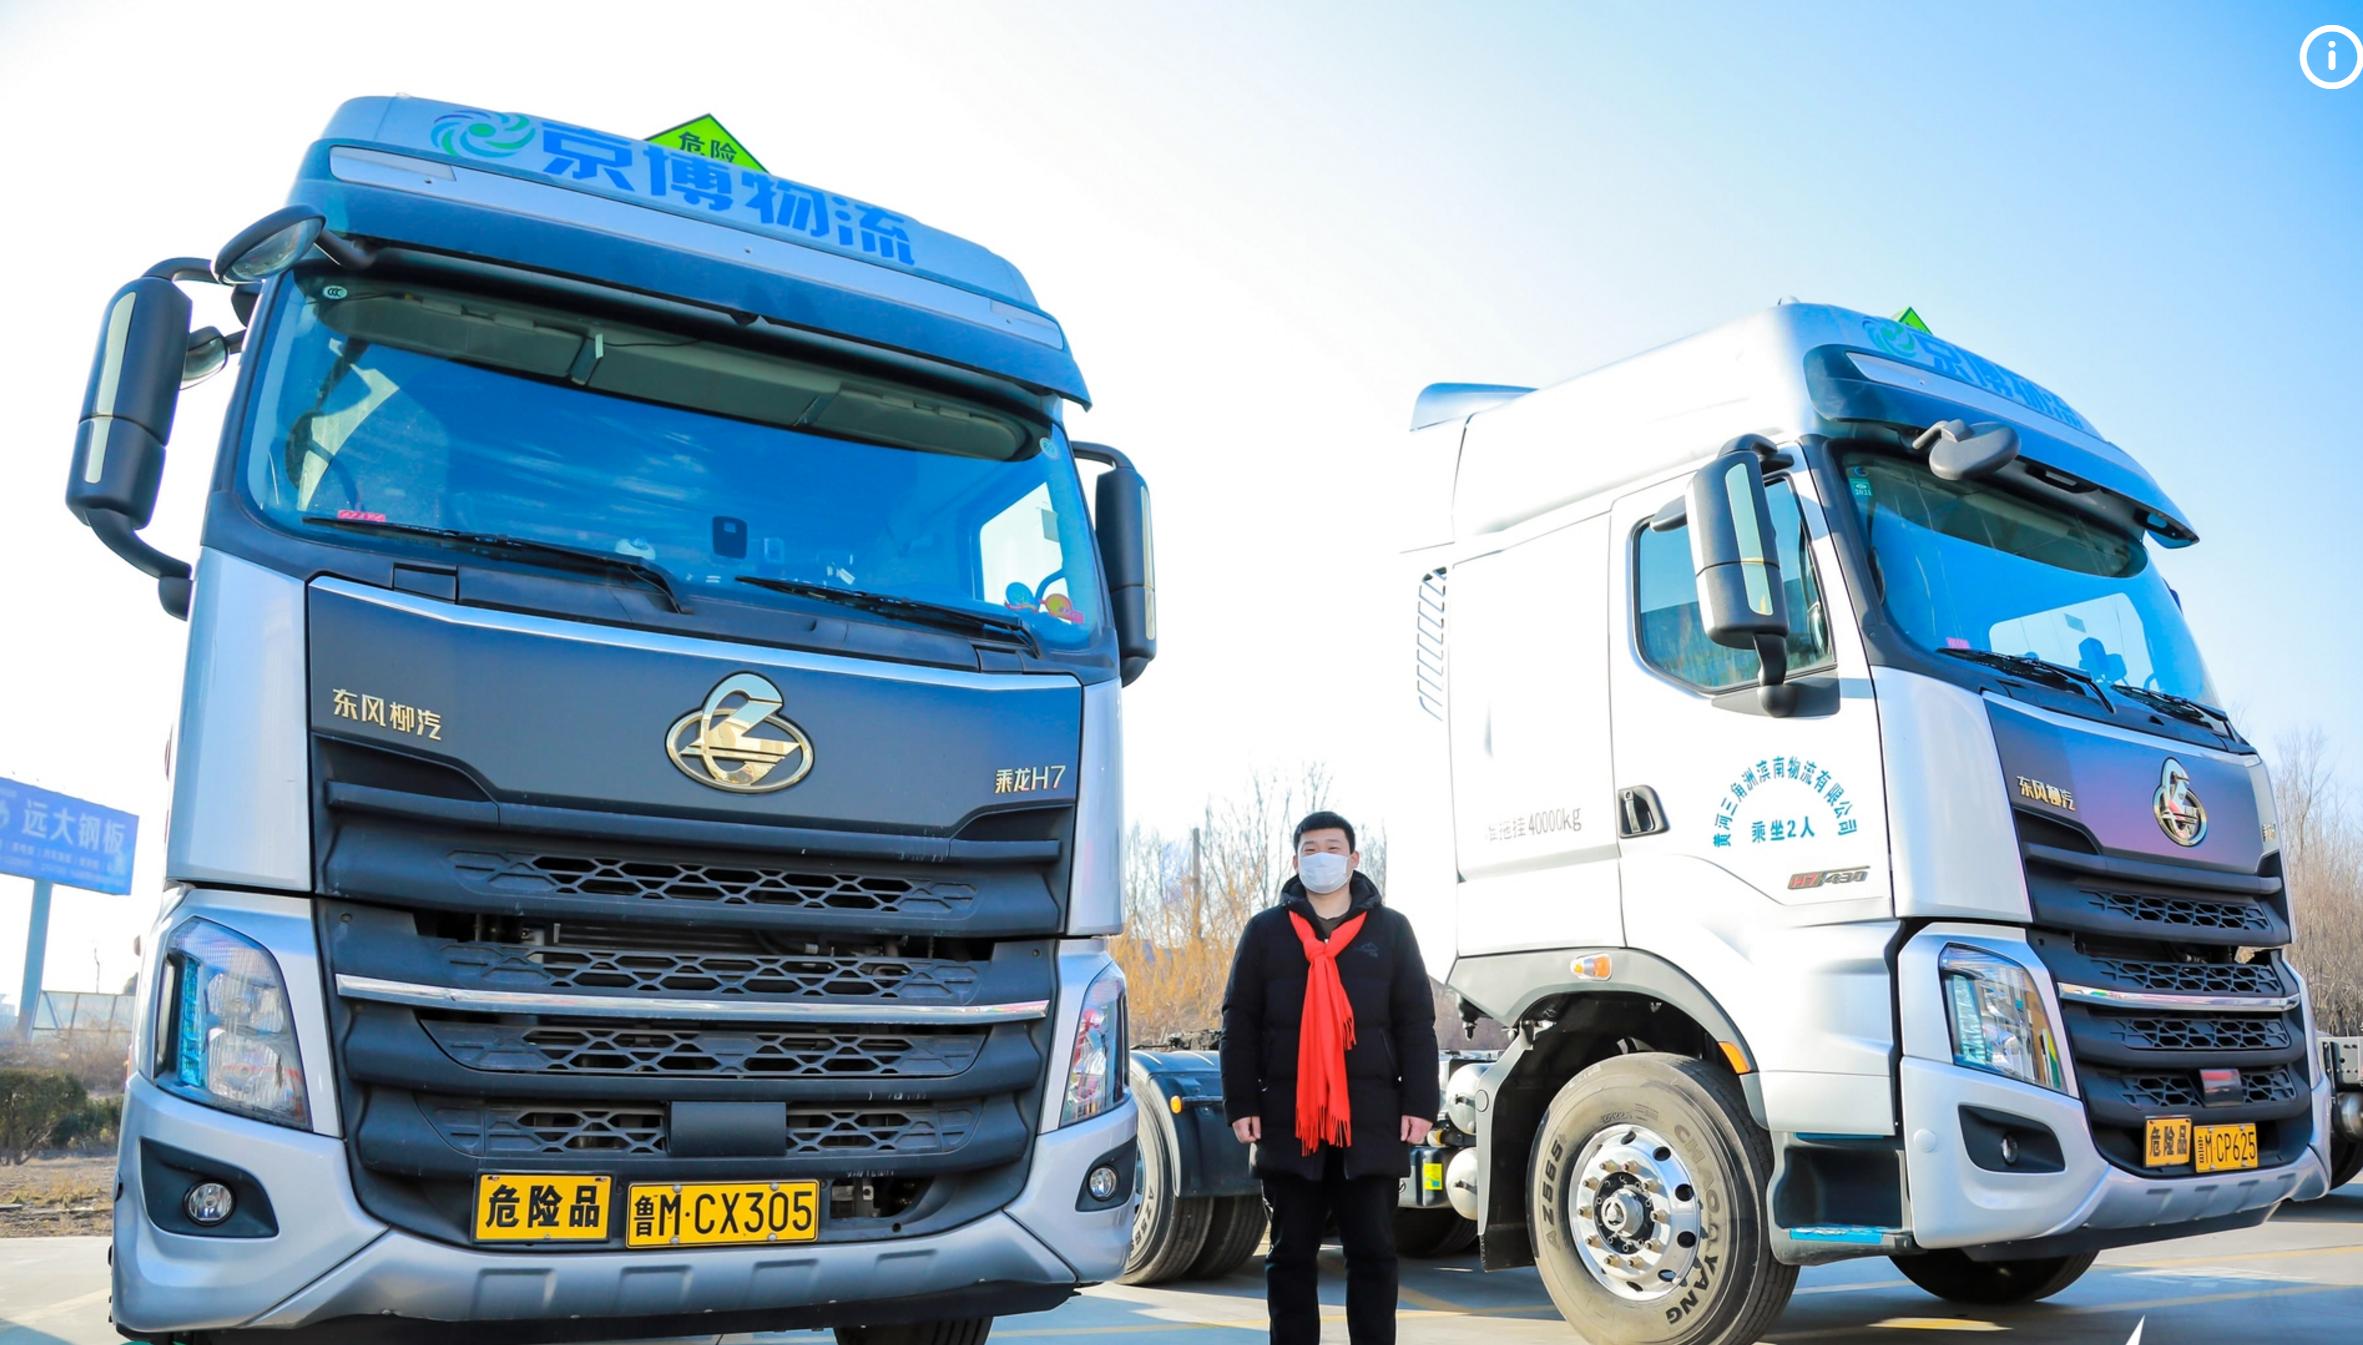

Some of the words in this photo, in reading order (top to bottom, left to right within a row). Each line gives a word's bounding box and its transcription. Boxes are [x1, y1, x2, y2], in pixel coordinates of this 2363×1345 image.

[679, 132, 736, 162] 危险
[543, 121, 915, 266] 京博物流
[333, 688, 441, 740] 东风柳汽
[22, 800, 126, 855] 远大钢板
[1752, 815, 1815, 843] 乘坐2人
[486, 1184, 601, 1229] 危险品
